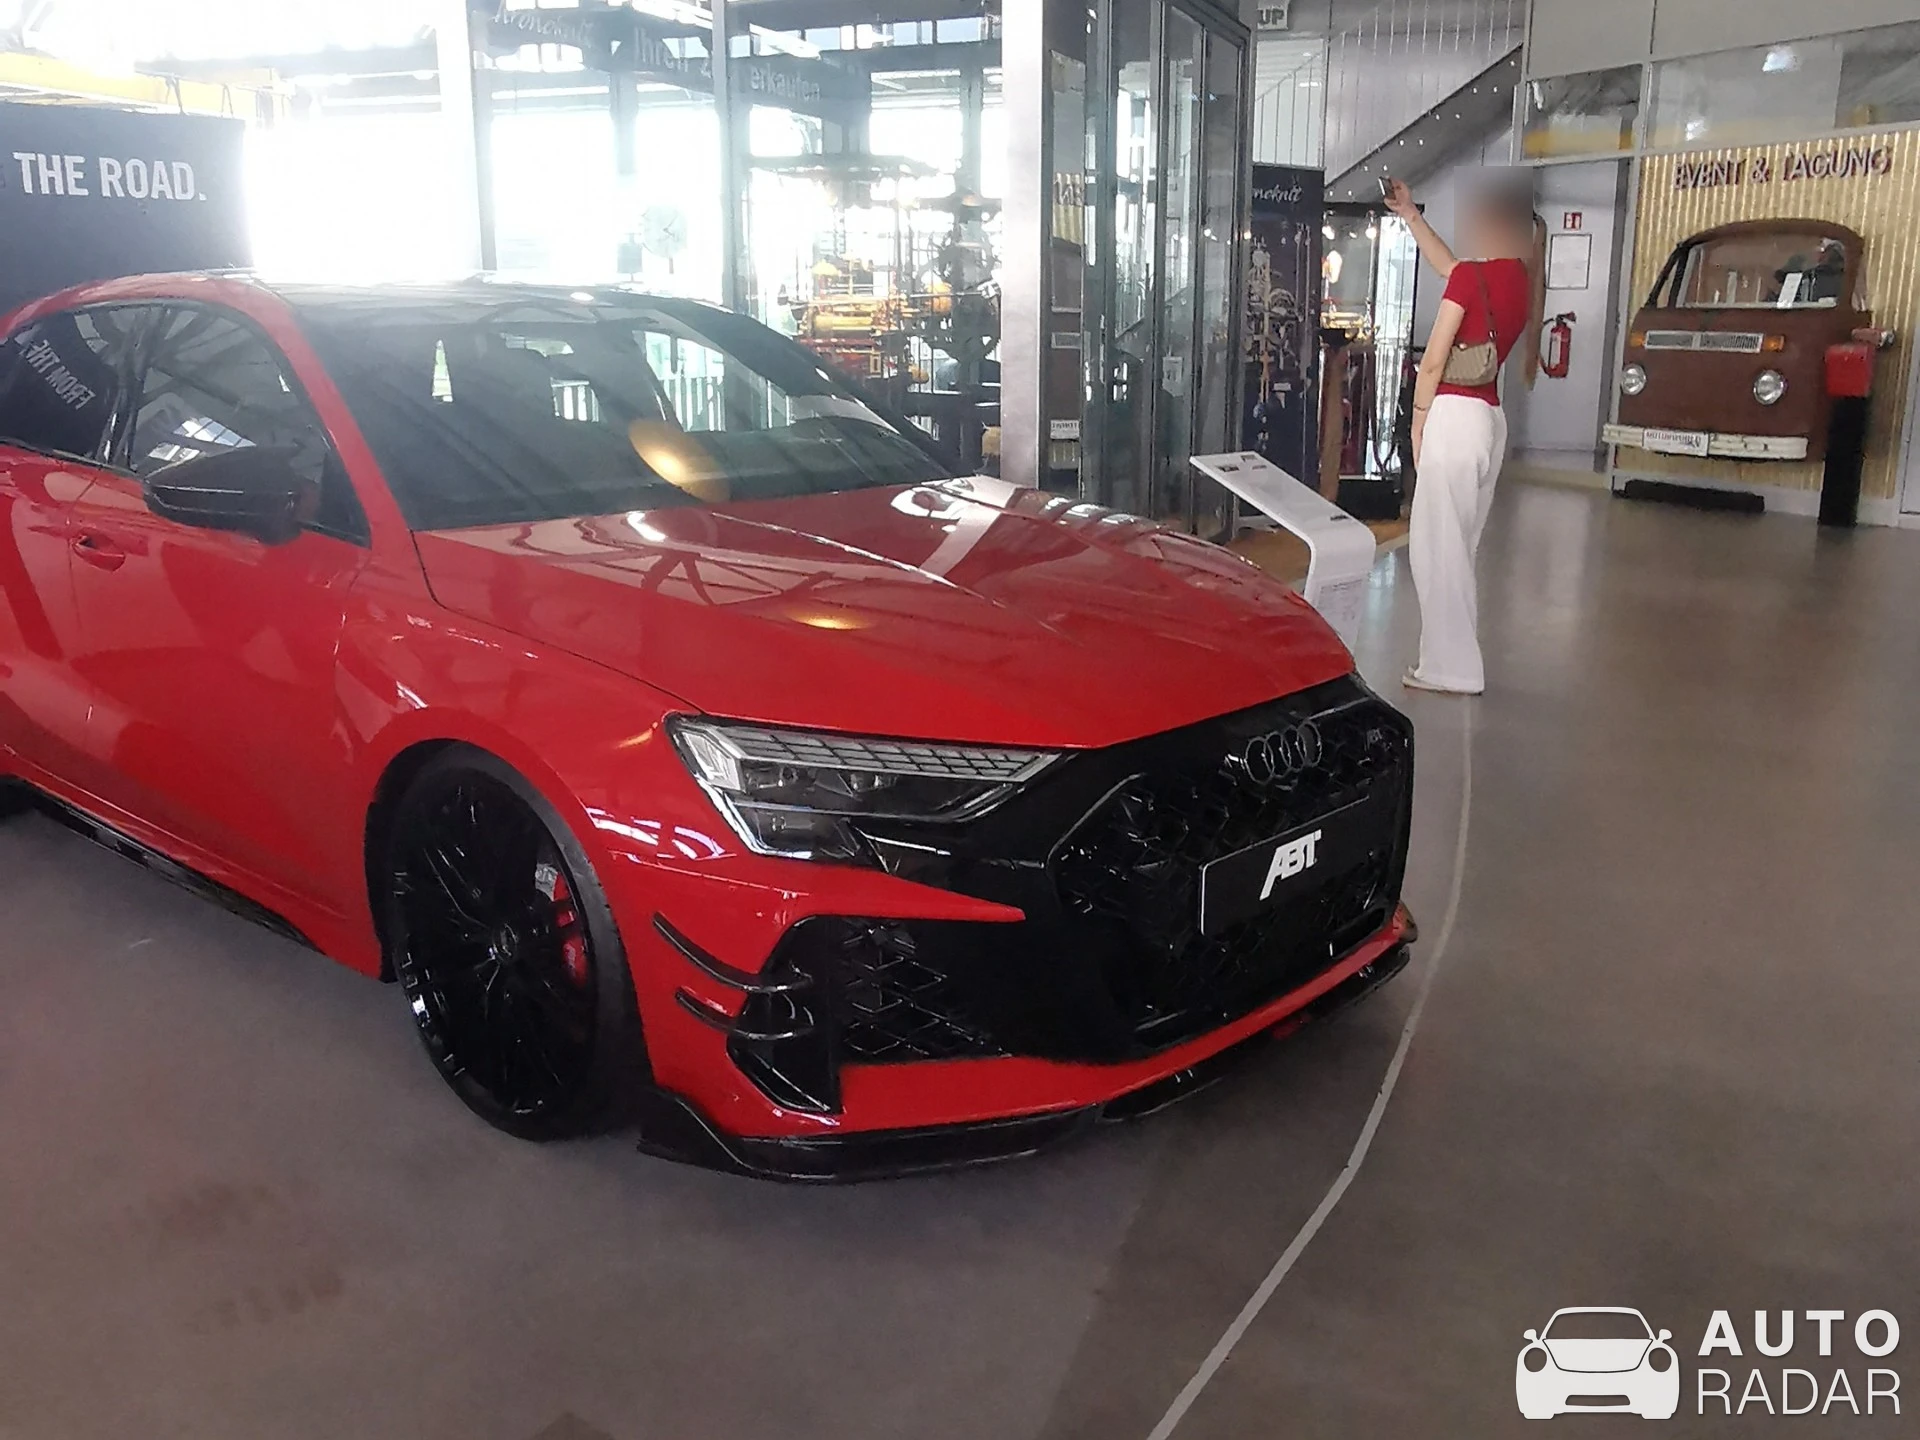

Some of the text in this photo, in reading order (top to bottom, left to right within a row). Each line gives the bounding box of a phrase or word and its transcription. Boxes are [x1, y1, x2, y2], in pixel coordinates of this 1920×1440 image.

[12, 151, 207, 201] THE ROAD.
[1673, 146, 1892, 190] EVENT & TAGUNG
[1259, 829, 1322, 901] ABT
